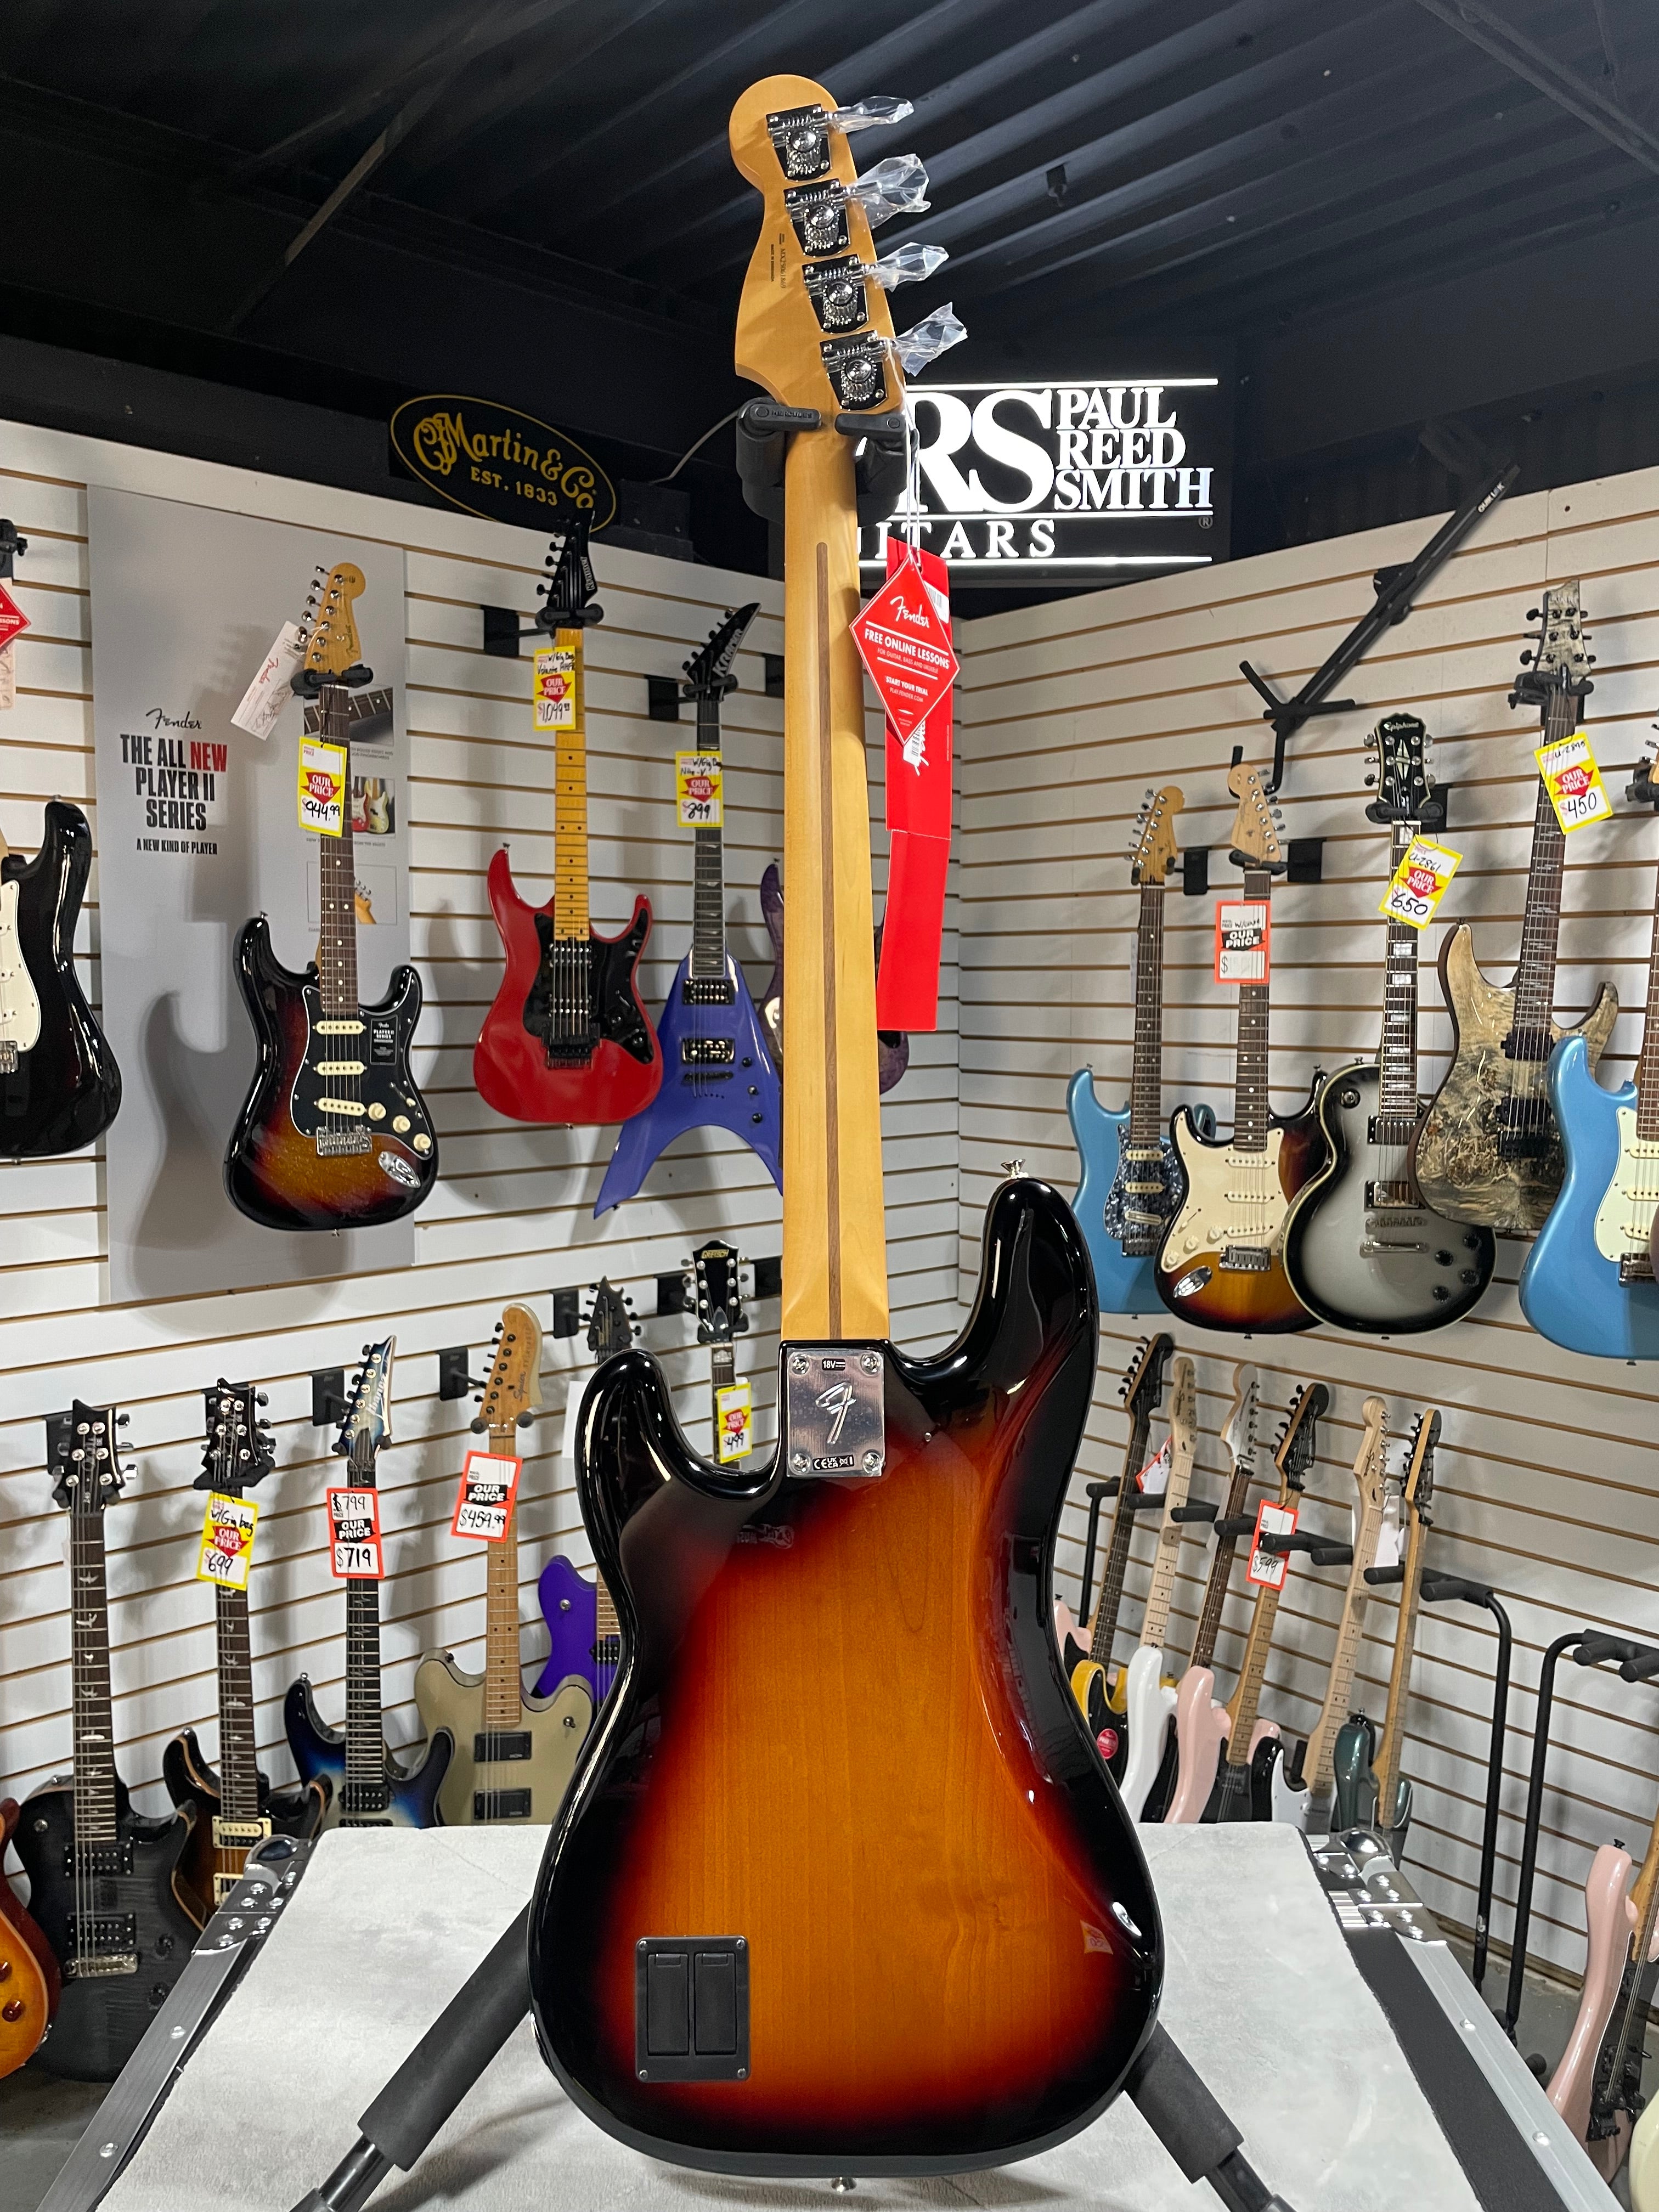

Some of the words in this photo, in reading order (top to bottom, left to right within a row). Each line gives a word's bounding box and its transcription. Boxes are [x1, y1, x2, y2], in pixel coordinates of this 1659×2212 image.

[1056, 387, 1177, 430] PAUL
[1056, 428, 1187, 470] REED
[470, 466, 509, 491] EST.
[516, 481, 558, 506] 1833
[1054, 467, 1214, 511] SMITH
[857, 520, 1056, 559] ITARS
[889, 595, 930, 629] Fender
[865, 628, 883, 645] FREE
[884, 636, 916, 657] ONLINE
[917, 648, 950, 669] LESSONS
[546, 678, 563, 686] OUR
[885, 675, 901, 686] START
[901, 680, 916, 691] YOUR
[916, 685, 929, 696] TRIAL
[544, 686, 566, 696] PRICE
[145, 708, 202, 729] Fender
[120, 733, 153, 765] THE
[157, 738, 187, 768] ALL
[190, 741, 228, 772] NEW
[312, 774, 331, 787] OUR
[1562, 768, 1585, 783] OUR
[136, 766, 199, 800] PLAYER
[203, 772, 215, 802] II
[309, 784, 334, 798] PRICE
[689, 787, 713, 795] PRICE
[690, 780, 710, 788] OUR
[1562, 775, 1590, 794] PRICE
[1559, 792, 1597, 819] $450
[146, 799, 207, 831] SERIES
[137, 838, 142, 851] A
[143, 839, 160, 852] NEW
[161, 839, 179, 853] KIND
[180, 841, 190, 854] OF
[191, 842, 217, 855] PLAYER
[1414, 870, 1435, 884] OUR
[1407, 877, 1435, 894] PRICE
[1229, 929, 1254, 940] OUR
[1226, 936, 1260, 949] PRICE
[822, 1360, 837, 1369] 18V
[727, 1418, 744, 1430] PRICE
[728, 1412, 743, 1421] OUR
[473, 1484, 500, 1493] OUR
[467, 1492, 505, 1502] PRICE
[341, 1519, 365, 1531] OUR
[219, 1528, 240, 1541] OUR
[338, 1527, 371, 1540] PRICE
[214, 1538, 242, 1551] PRICE
[336, 1547, 371, 1568] $719
[1252, 1555, 1279, 1575] $599
